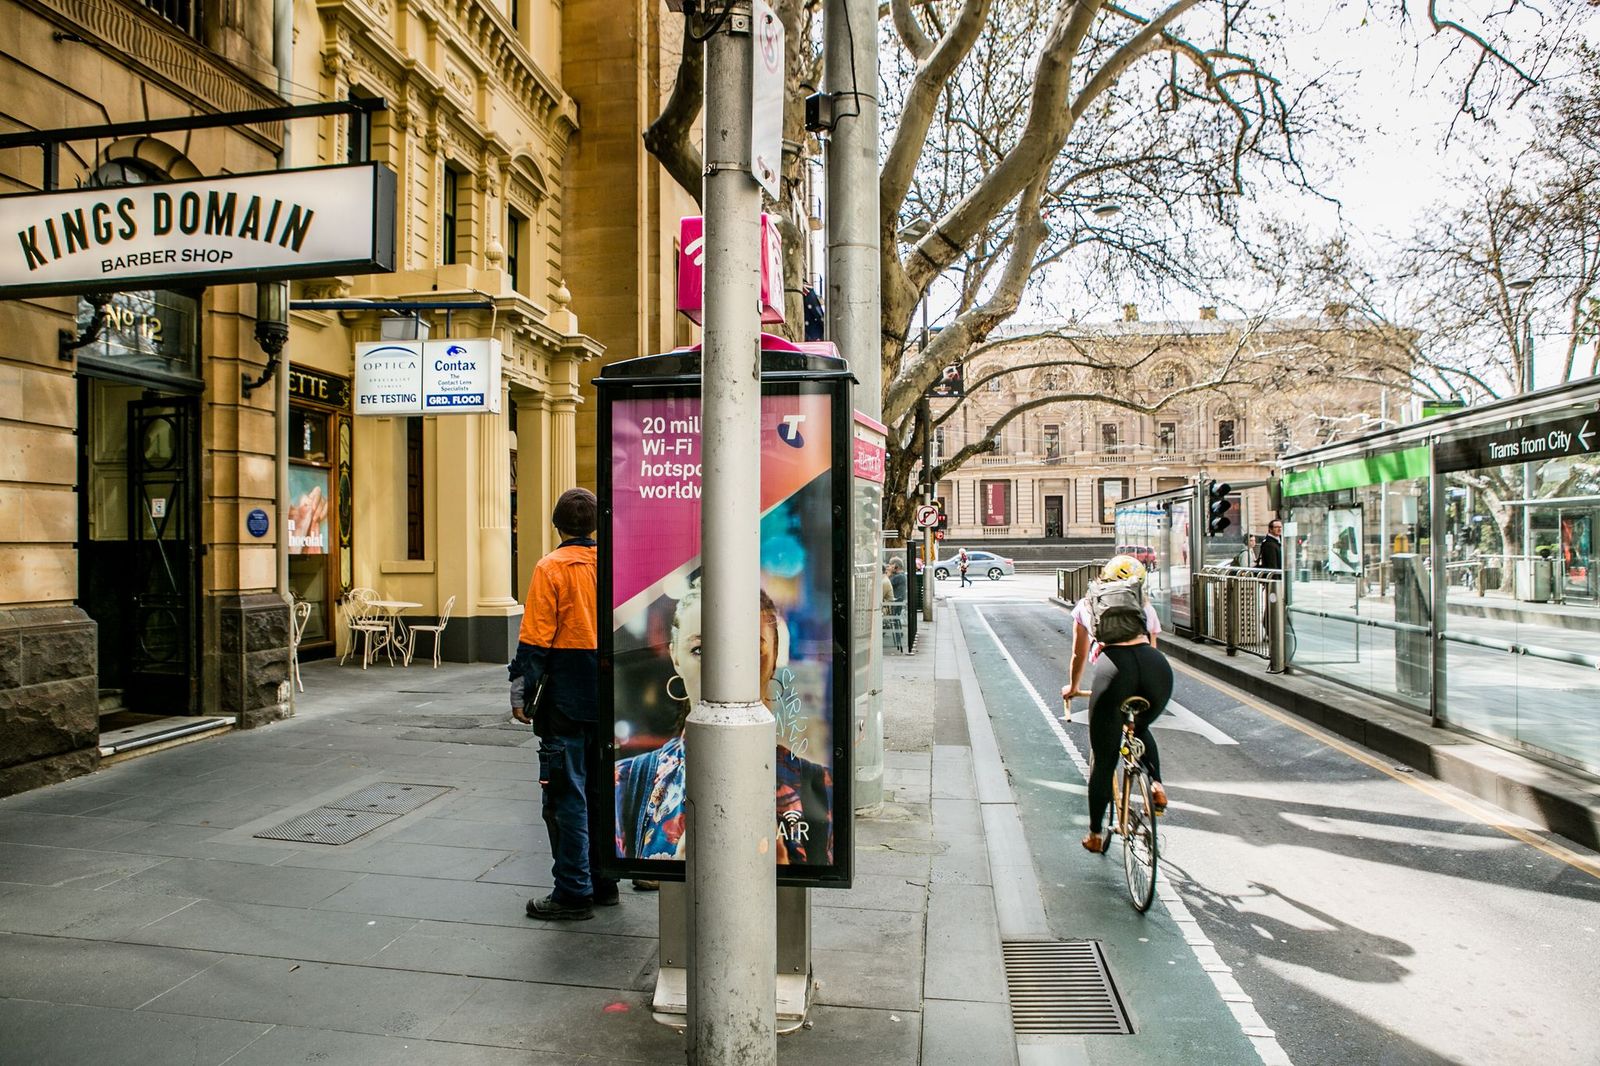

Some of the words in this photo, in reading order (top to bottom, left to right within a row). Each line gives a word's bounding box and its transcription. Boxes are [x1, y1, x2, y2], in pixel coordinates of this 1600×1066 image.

[18, 197, 136, 271] KINGS
[153, 191, 314, 253] DOMAIN
[101, 250, 177, 272] BARBER
[181, 248, 233, 263] SHOP
[142, 314, 162, 341] 12
[363, 361, 416, 371] OPTICA
[434, 360, 476, 371] Contax
[360, 394, 378, 404] EYE
[380, 393, 417, 403] TESTING
[428, 396, 451, 404] GRD.
[452, 395, 482, 404] FLOOR
[642, 416, 666, 434] 20
[670, 416, 702, 434] mil
[642, 438, 693, 456] Wi-Fi
[1489, 441, 1520, 460] Trams
[1521, 436, 1546, 454] from
[1548, 431, 1572, 452] City
